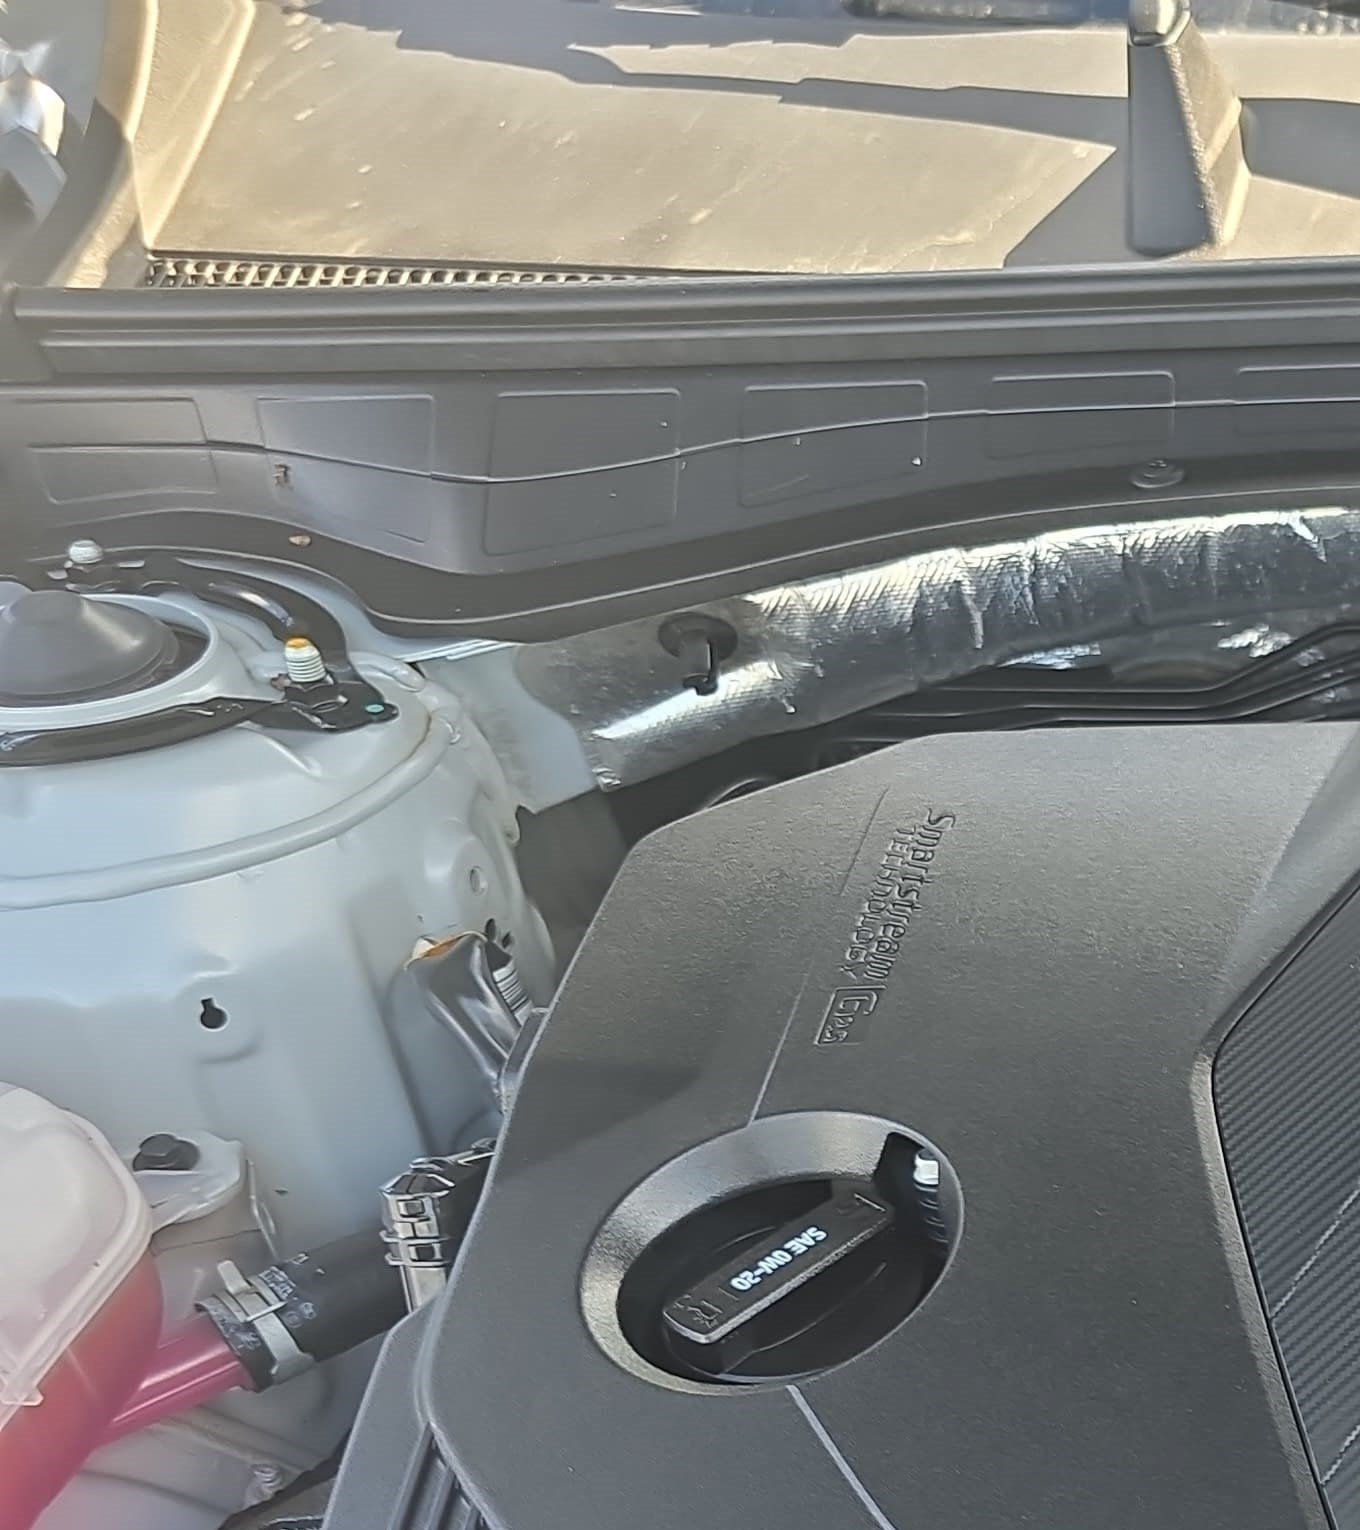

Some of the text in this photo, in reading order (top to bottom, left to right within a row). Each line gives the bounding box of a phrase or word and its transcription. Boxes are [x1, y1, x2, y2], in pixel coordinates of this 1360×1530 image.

[841, 827, 917, 980] TECHNOLOGY
[864, 807, 956, 981] Smartstream
[730, 1227, 827, 1291] SAE 0W-20
